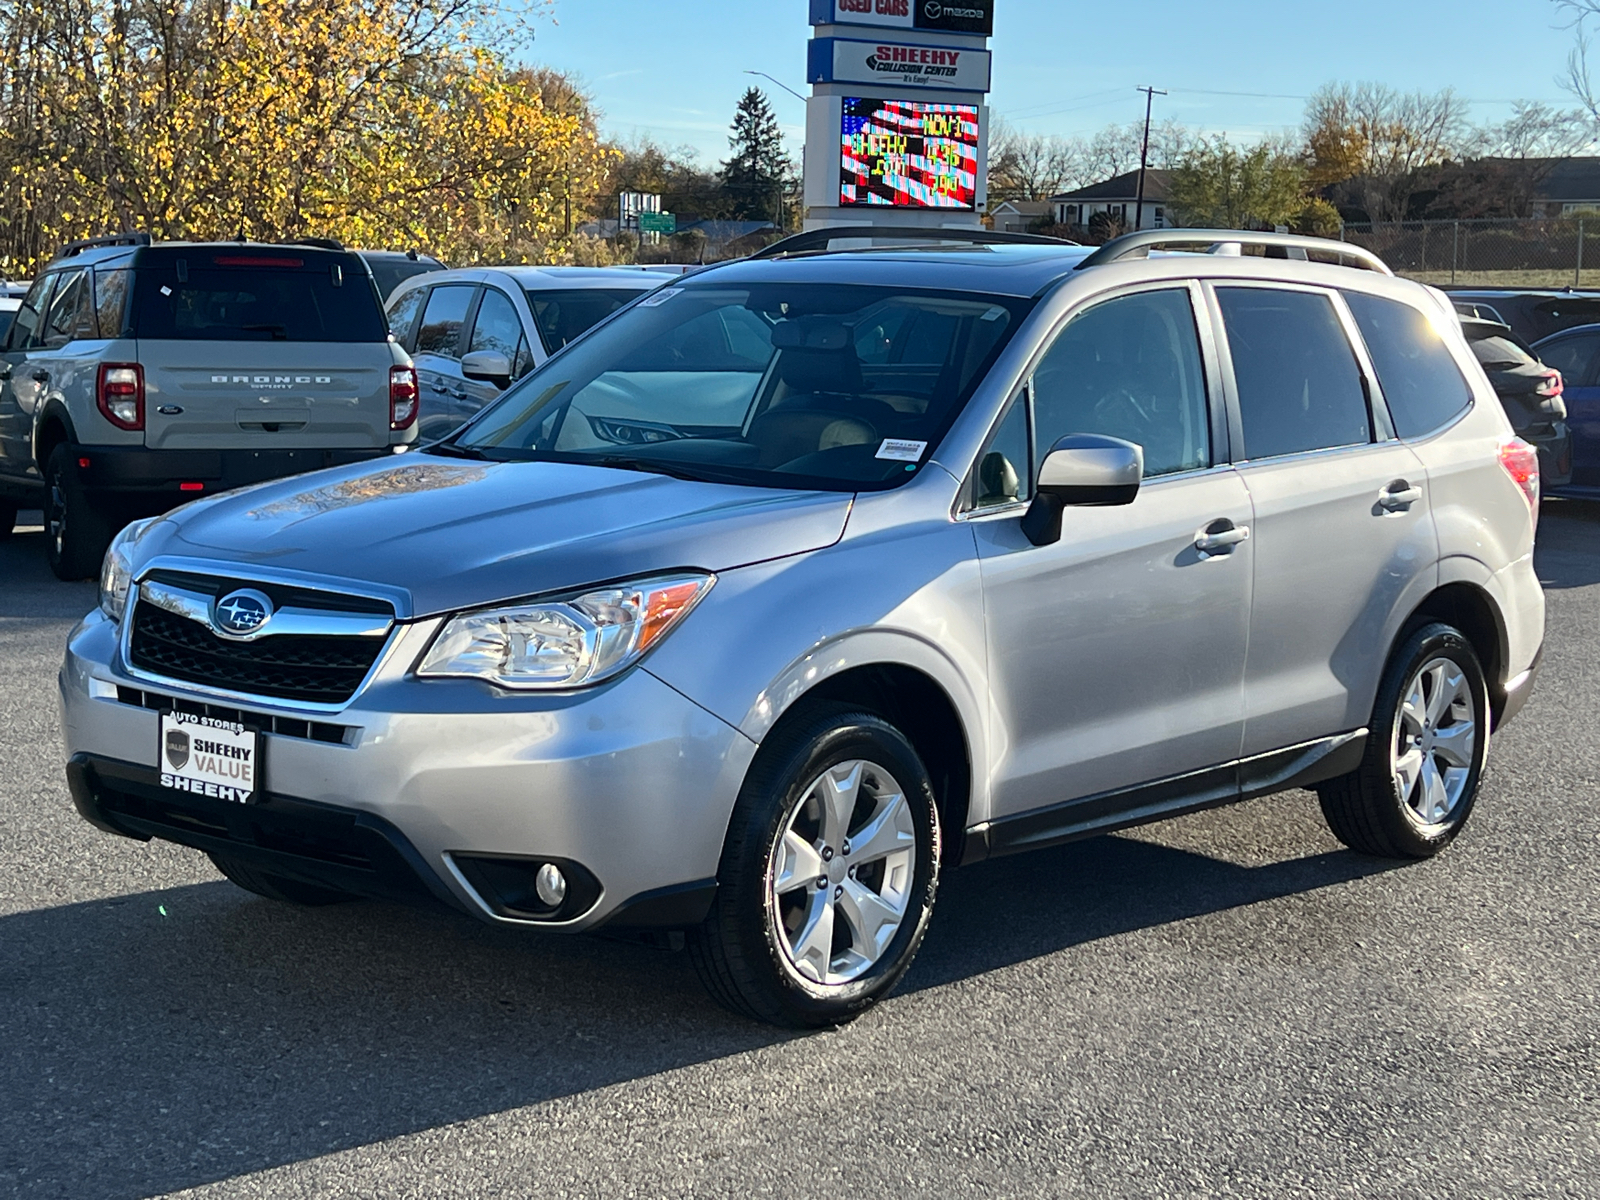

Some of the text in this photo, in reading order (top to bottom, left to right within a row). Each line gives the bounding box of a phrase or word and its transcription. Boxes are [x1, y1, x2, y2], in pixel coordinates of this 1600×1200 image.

[839, 0, 909, 17] USED CARS
[943, 8, 984, 19] mazda
[876, 46, 960, 65] SHEEHY
[876, 62, 958, 77] COLLISION CENTER
[211, 375, 331, 384] BRONCO
[170, 710, 244, 733] AUTO STORES
[194, 739, 251, 761] SHEEHY
[194, 754, 251, 782] VALUE
[160, 773, 251, 804] SHEEHY
